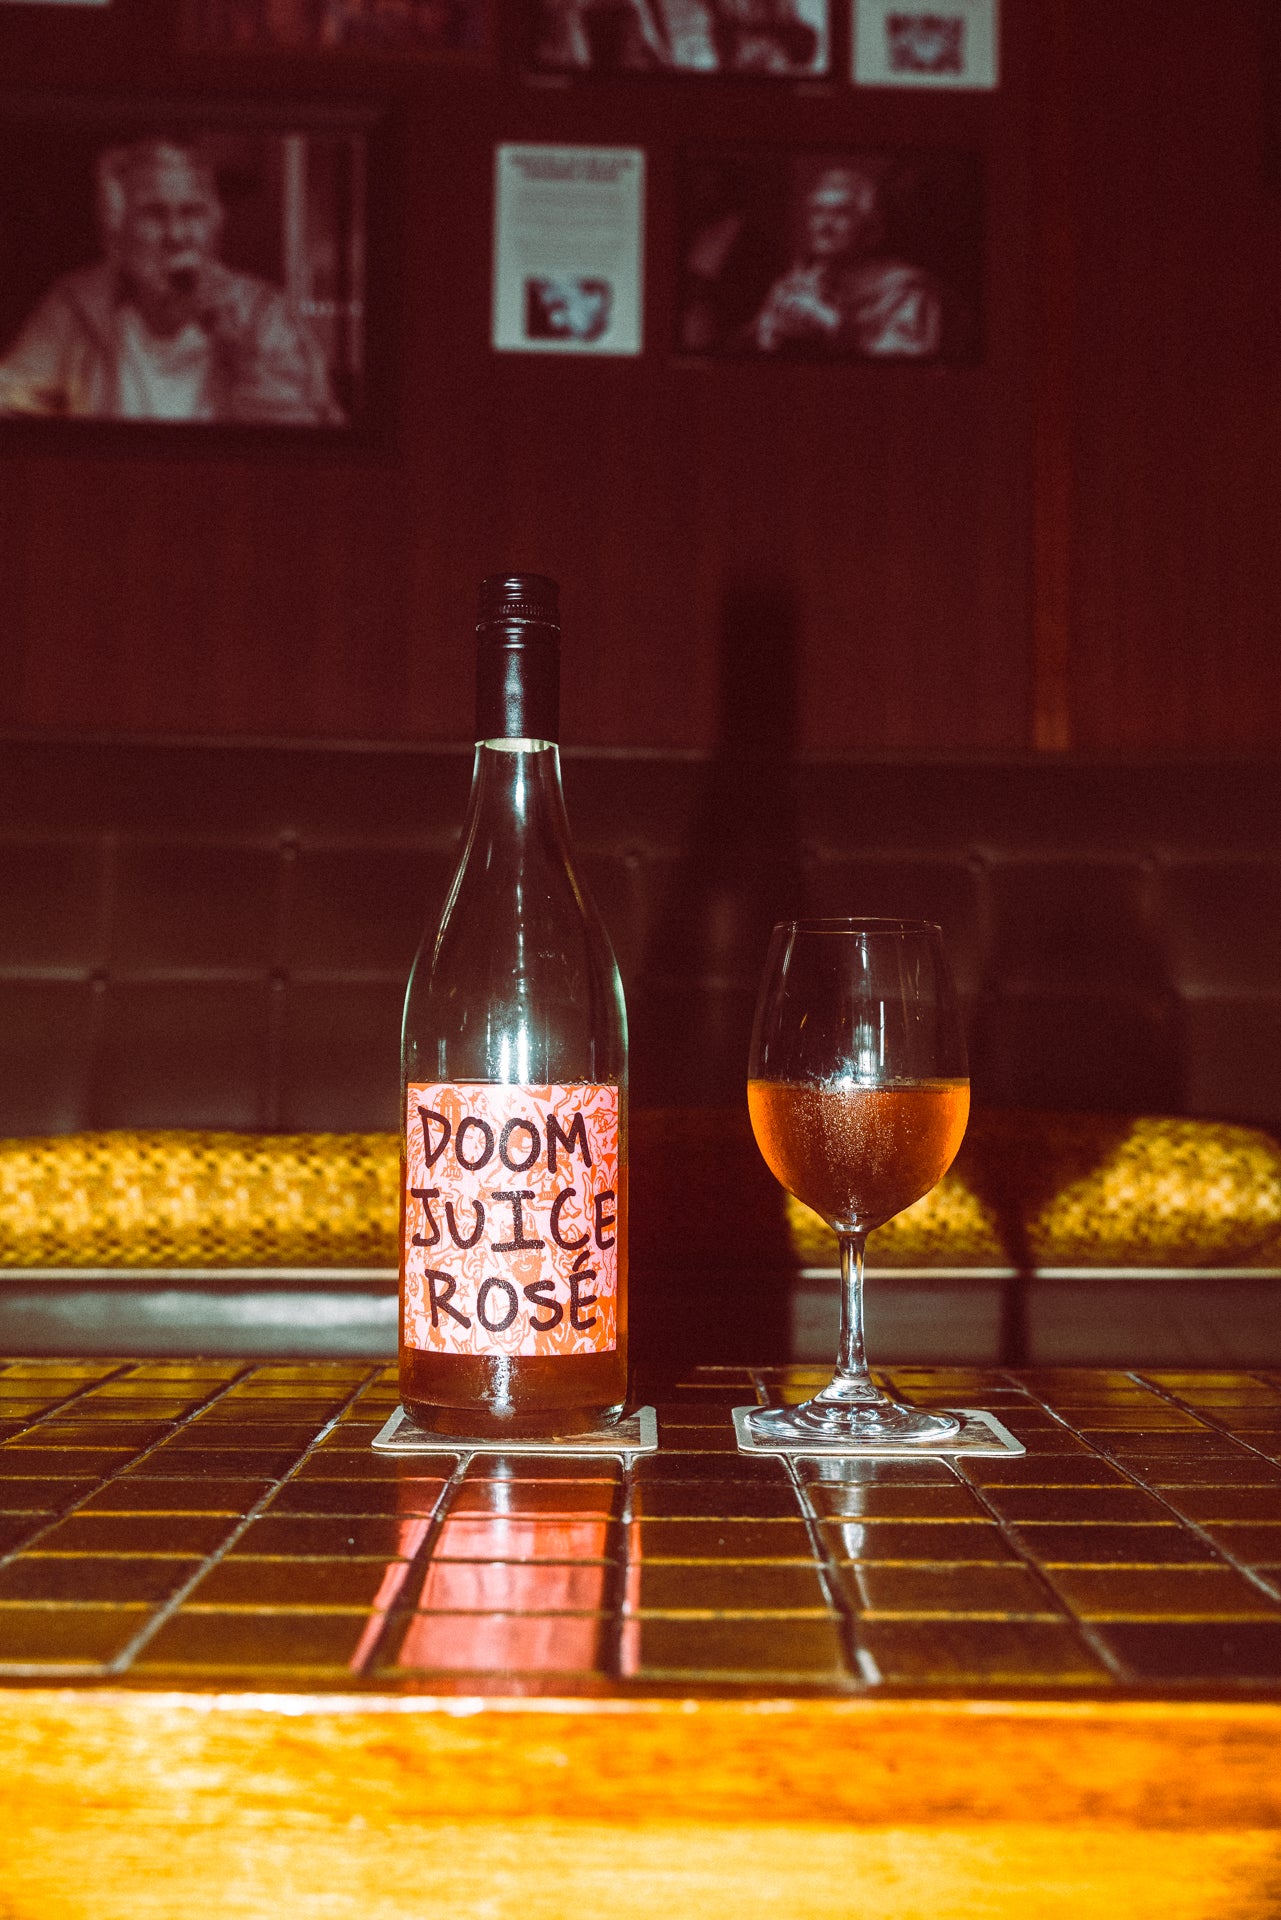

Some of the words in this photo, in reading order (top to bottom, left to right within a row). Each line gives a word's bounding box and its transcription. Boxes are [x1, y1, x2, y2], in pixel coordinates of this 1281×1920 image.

[417, 1105, 592, 1174] DOOM
[410, 1187, 617, 1252] JUICE
[424, 1249, 598, 1333] ROSÉ
